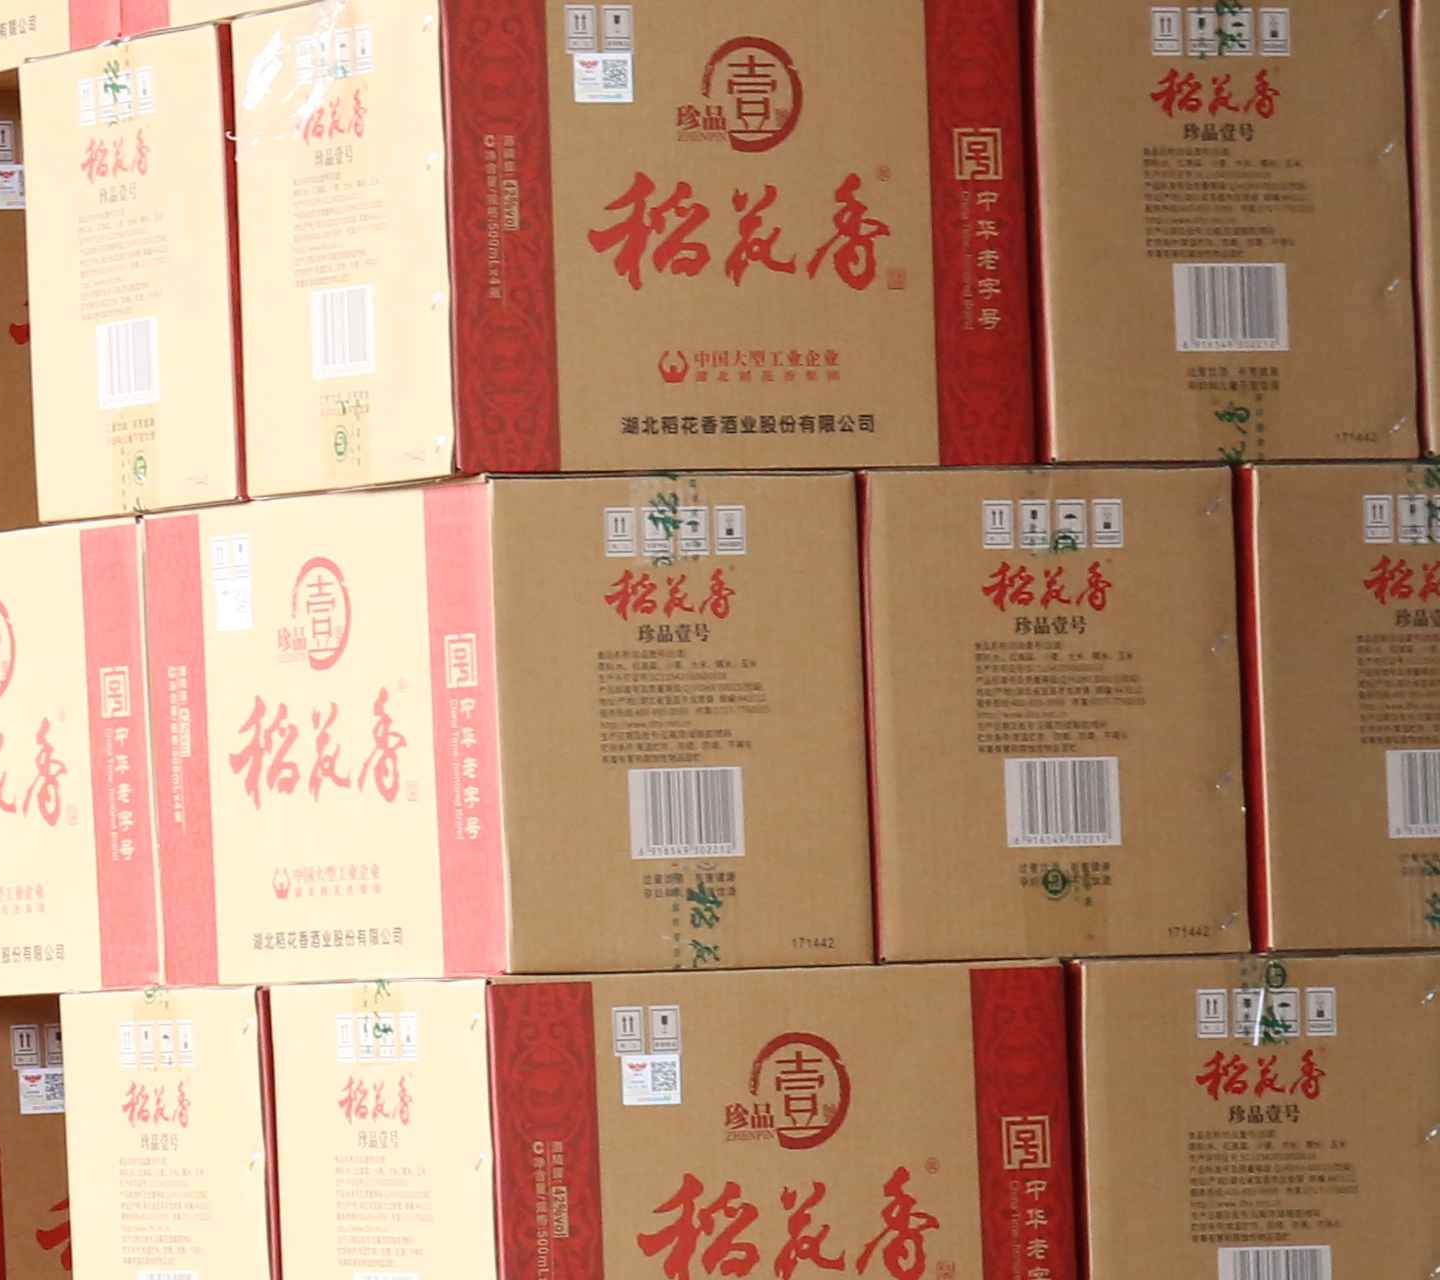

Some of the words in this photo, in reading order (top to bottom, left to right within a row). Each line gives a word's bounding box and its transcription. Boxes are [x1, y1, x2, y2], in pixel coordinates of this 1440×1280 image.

[300, 88, 369, 144] 稻花香
[1150, 68, 1282, 120] 稻花香
[1182, 122, 1255, 143] 珍品壹号
[78, 134, 148, 183] 稻花香
[588, 172, 890, 290] 稻花香
[976, 191, 1001, 331] 中华老字号
[693, 349, 839, 369] 中国大型工业企业
[621, 414, 875, 435] 湖北稻花香酒业股份有限公司
[602, 567, 732, 621] 稻花香
[980, 559, 1113, 613] 稻花香
[1363, 555, 1440, 605] 稻花
[637, 622, 710, 645] 珍品壹号
[1014, 614, 1088, 636] 珍品壹号
[229, 688, 407, 810] 稻花香
[253, 927, 403, 949] 湖北稻花香酒业股份有限公司
[1193, 1048, 1323, 1101] 稻花香
[120, 1083, 190, 1129] 稻花香
[336, 1077, 412, 1127] 稻花香
[1228, 1103, 1301, 1125] 珍品壹号
